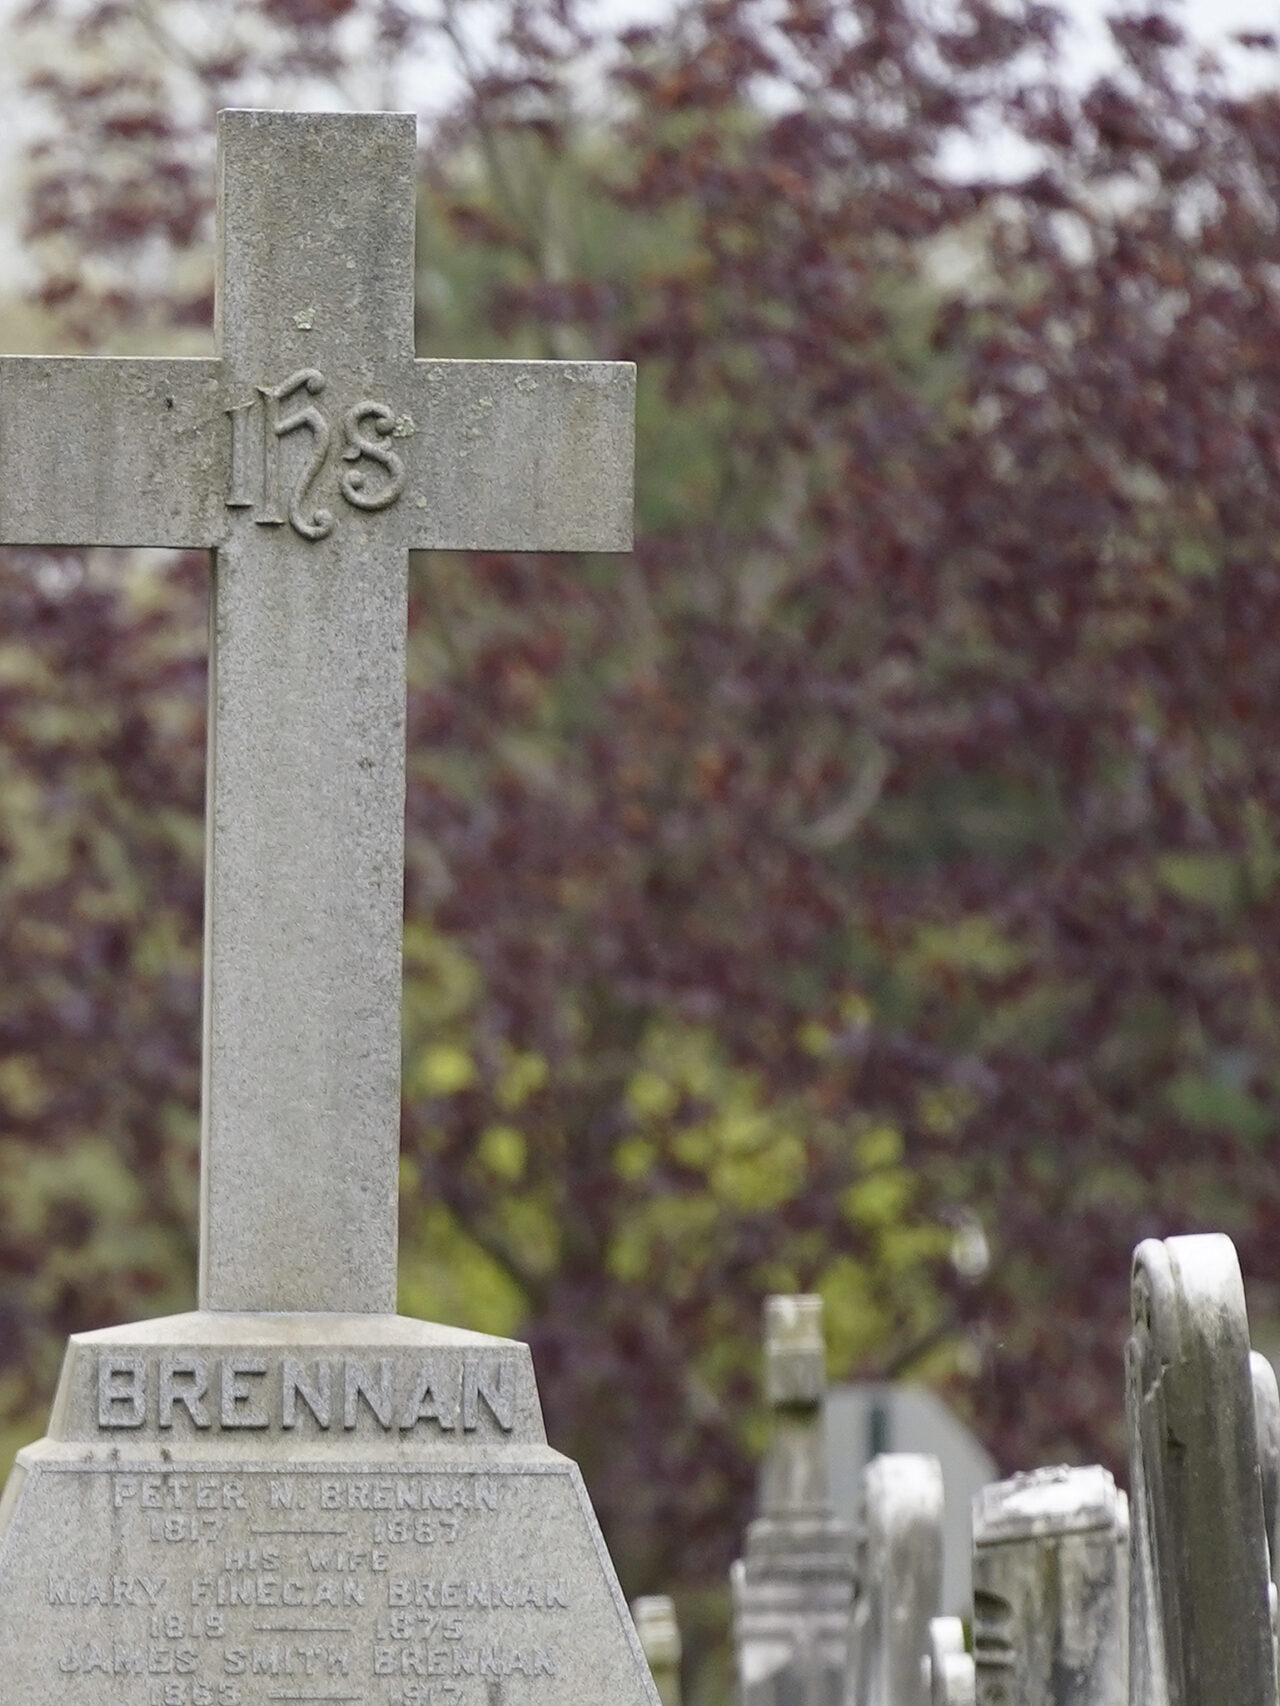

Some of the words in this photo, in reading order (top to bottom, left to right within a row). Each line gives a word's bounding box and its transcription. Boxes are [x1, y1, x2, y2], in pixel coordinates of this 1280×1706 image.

[94, 1354, 518, 1433] BRENNAN
[114, 1478, 248, 1511] PETER
[320, 1479, 498, 1511] BRENNAN
[150, 1514, 226, 1543] 1817
[224, 1549, 280, 1572] HIS
[306, 1548, 389, 1573] WIFE
[46, 1575, 169, 1607] MARY
[387, 1576, 569, 1609] BRENNAN
[375, 1611, 464, 1641] 1875
[58, 1645, 200, 1675] JAMES
[223, 1646, 349, 1677] SMITH
[372, 1646, 557, 1677] BRENNAN
